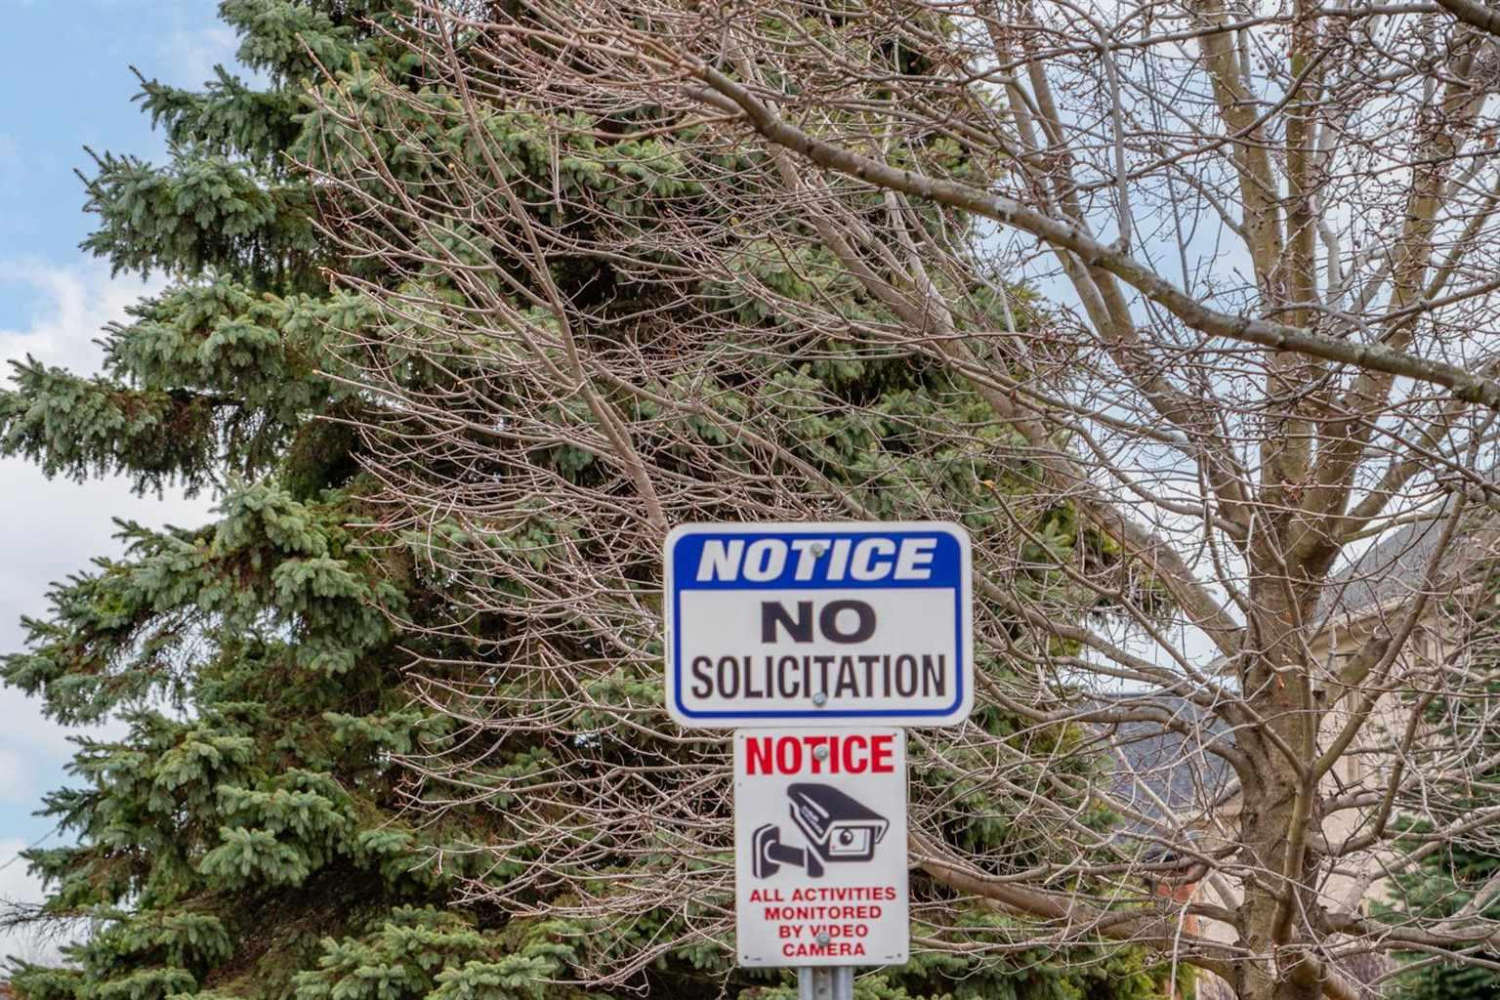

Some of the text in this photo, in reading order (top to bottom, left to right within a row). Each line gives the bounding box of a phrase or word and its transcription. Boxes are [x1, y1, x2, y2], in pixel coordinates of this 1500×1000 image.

[696, 538, 938, 582] NOTICE
[761, 599, 877, 644] NO
[691, 654, 946, 699] SOLICITATION
[746, 735, 895, 775] NOTICE
[750, 887, 896, 902] ALL ACTIVITIES
[764, 906, 882, 920] MONITORED
[778, 925, 803, 938] BY
[782, 943, 866, 957] CAMERA
